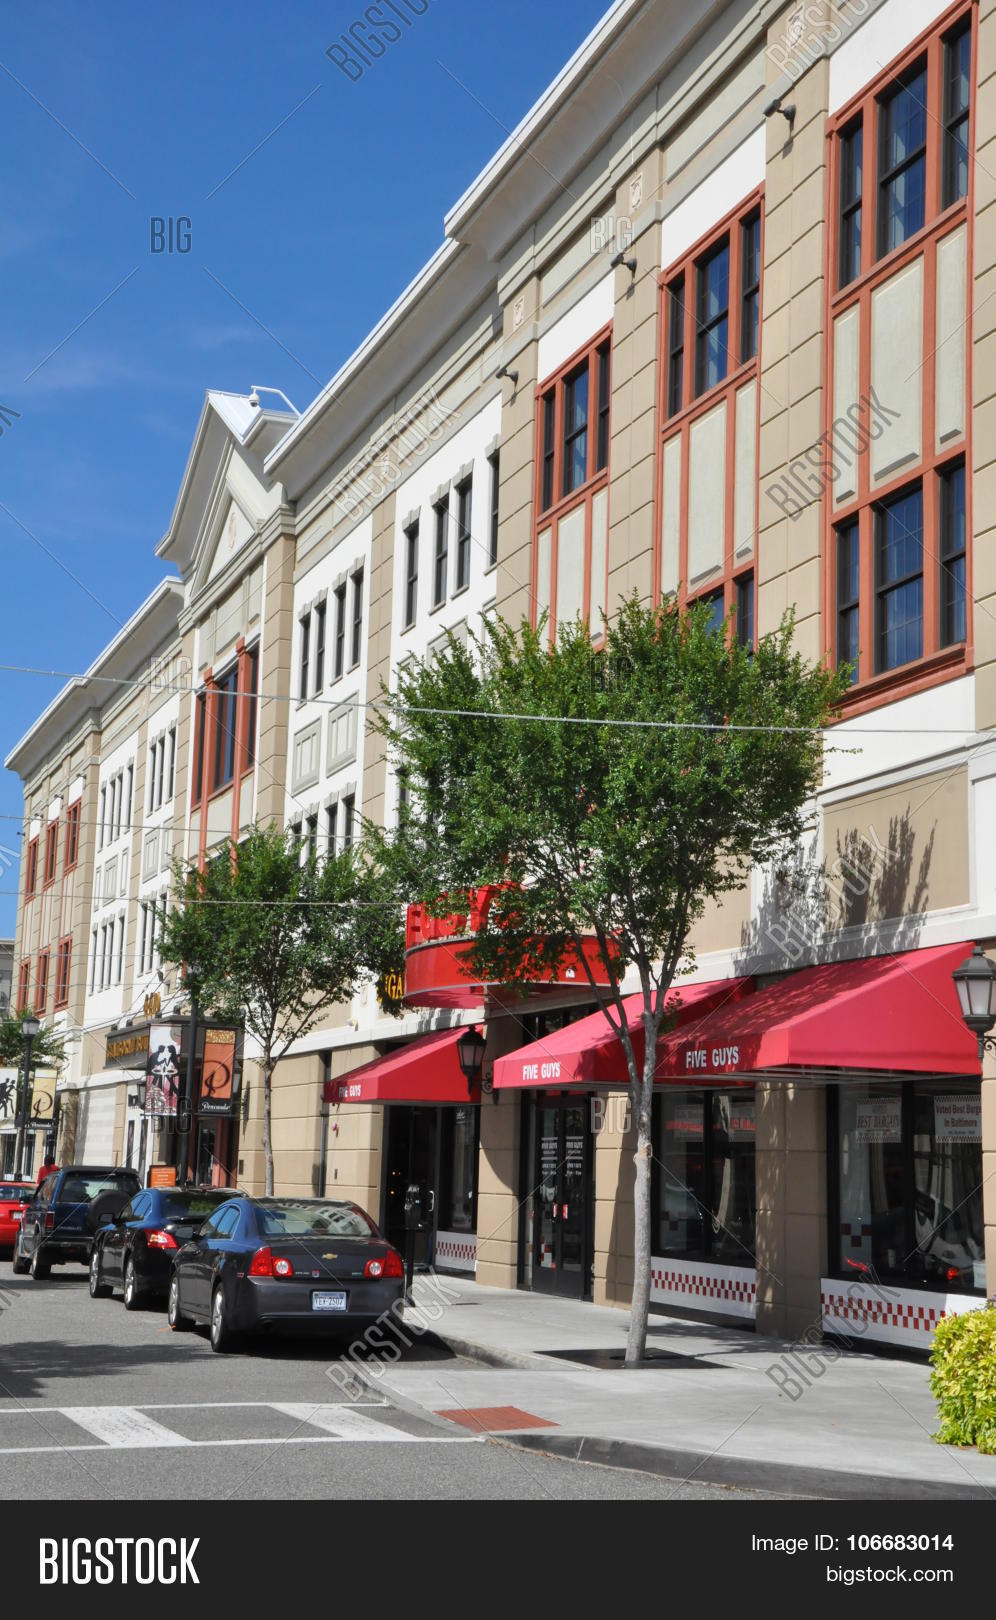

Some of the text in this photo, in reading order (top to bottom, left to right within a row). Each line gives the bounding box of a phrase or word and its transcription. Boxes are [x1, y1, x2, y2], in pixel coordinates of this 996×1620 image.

[686, 1046, 739, 1068] FIVE GUYS
[522, 1062, 560, 1080] FIVE GUYS
[339, 1084, 361, 1098] FIVE GUYS
